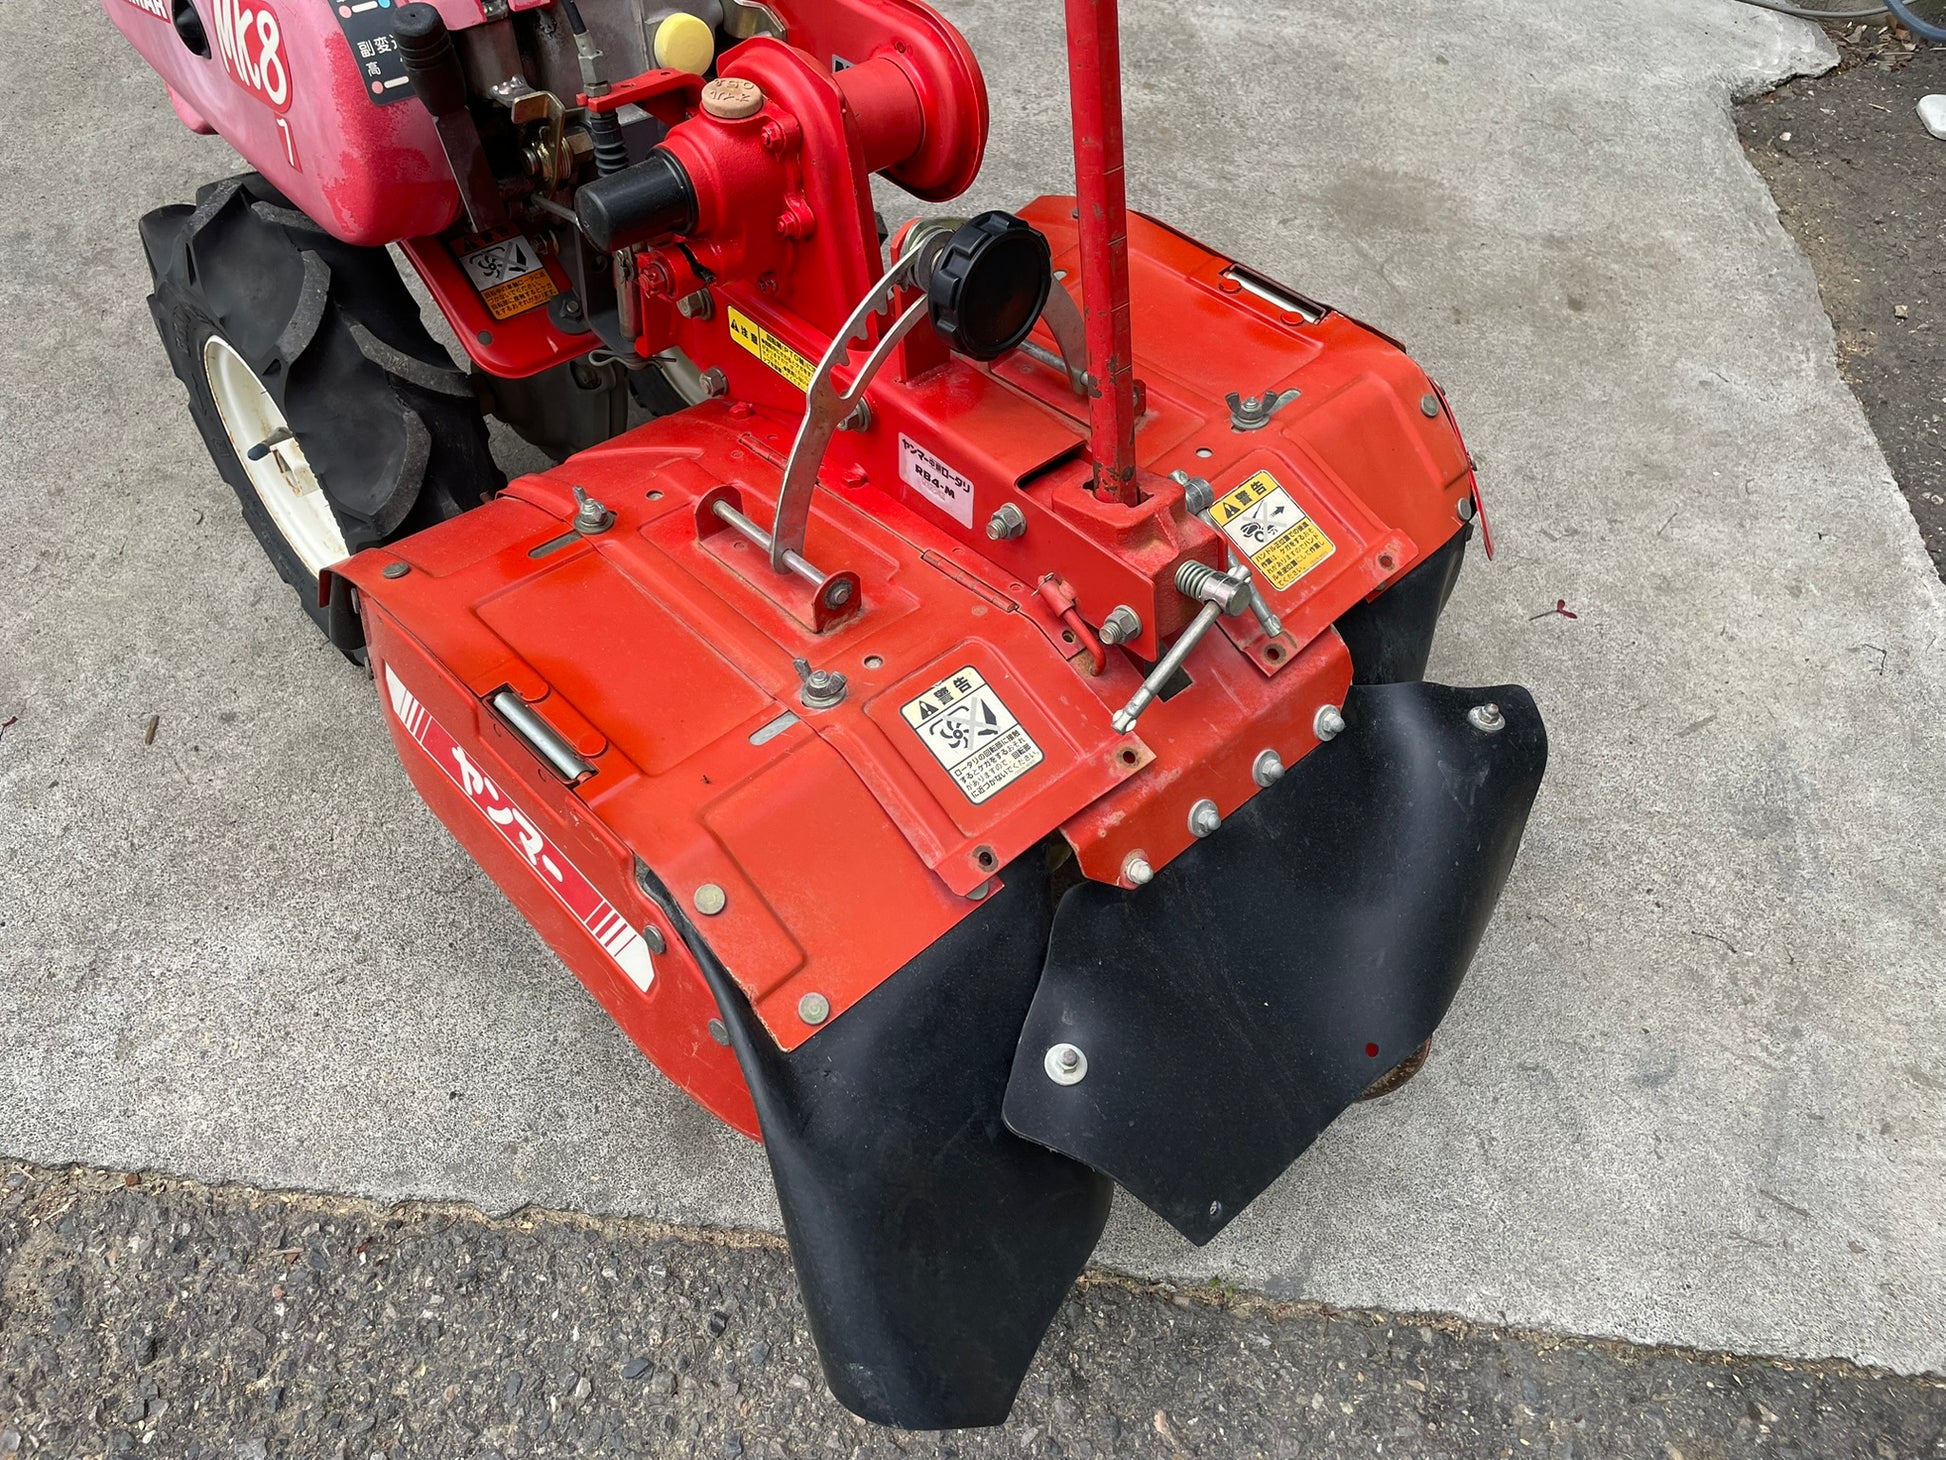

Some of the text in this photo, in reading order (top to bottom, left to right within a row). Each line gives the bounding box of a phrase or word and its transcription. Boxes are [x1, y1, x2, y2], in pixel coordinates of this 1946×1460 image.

[366, 61, 381, 76] 高
[1235, 480, 1267, 505] 警告
[933, 676, 972, 705] 警告
[954, 729, 1021, 777] ロータリの回転部に接触
[960, 737, 1026, 784] するとケガをするおそれ
[451, 746, 563, 883] ヤンマー
